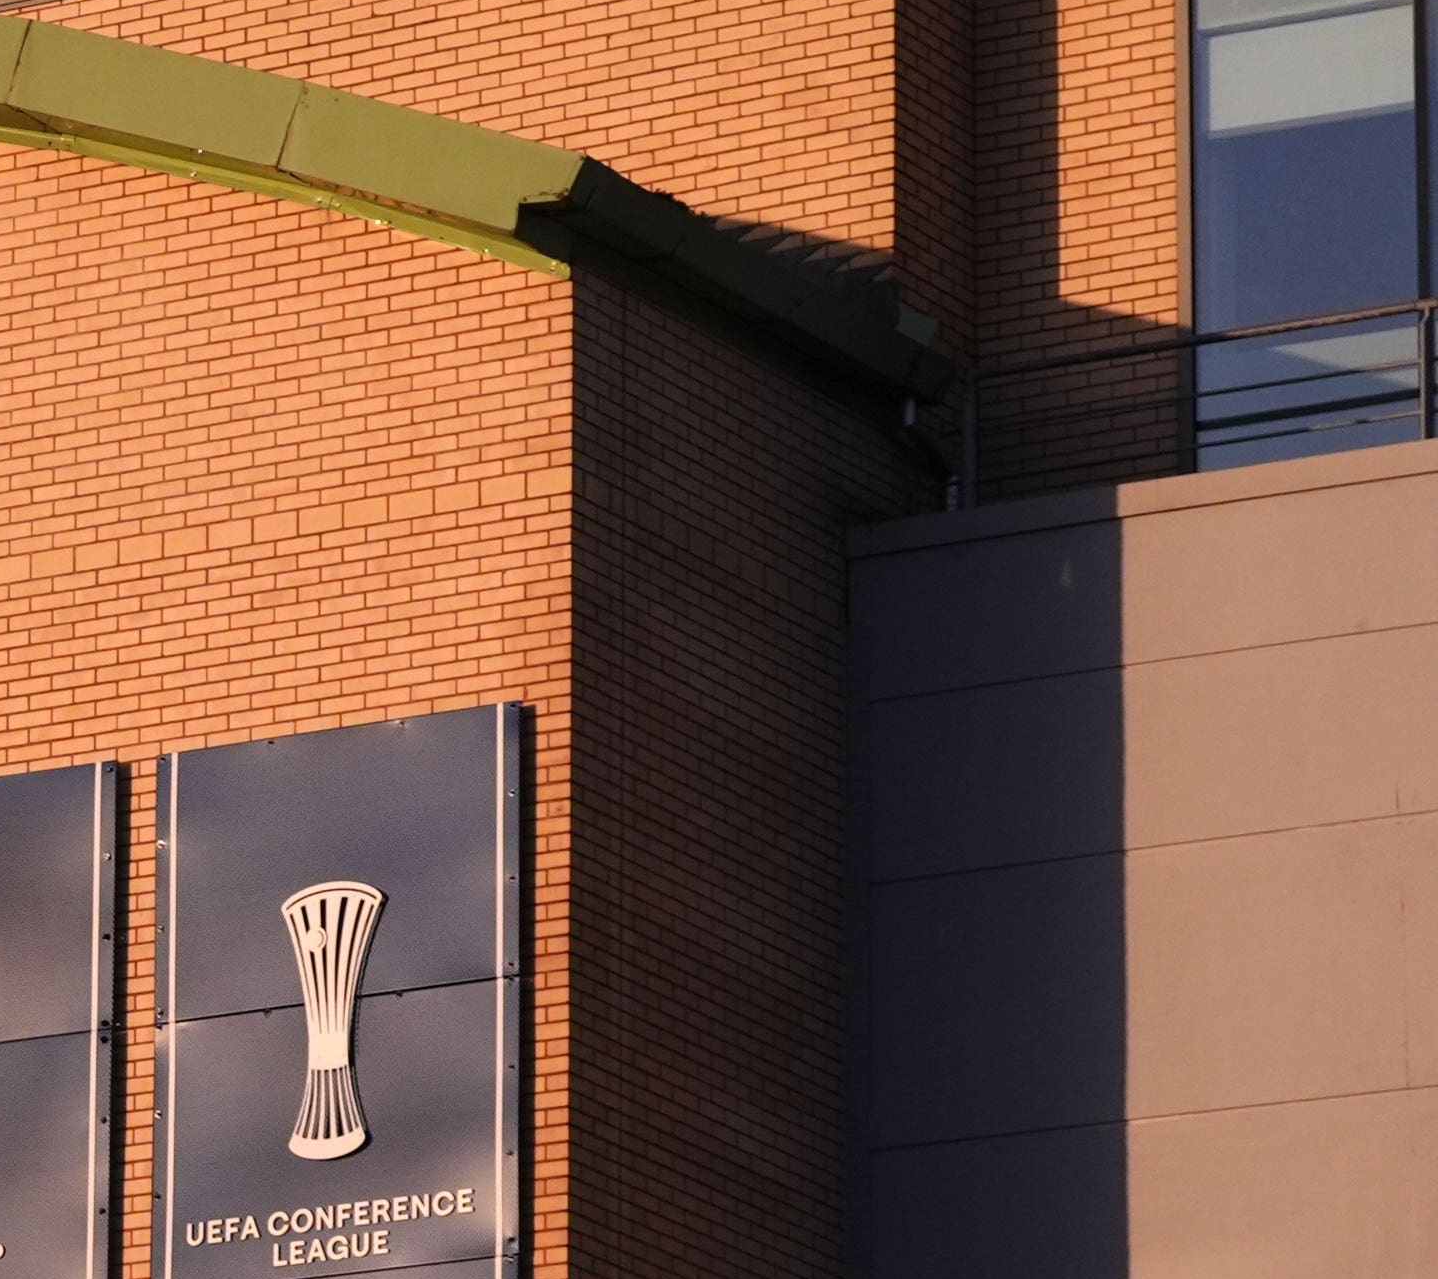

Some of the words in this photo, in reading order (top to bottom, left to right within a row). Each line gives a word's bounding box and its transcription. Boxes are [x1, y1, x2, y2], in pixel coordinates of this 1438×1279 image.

[186, 1216, 259, 1247] UEFA
[267, 1188, 474, 1236] CONFERENCE
[272, 1231, 389, 1268] LEAGUE
